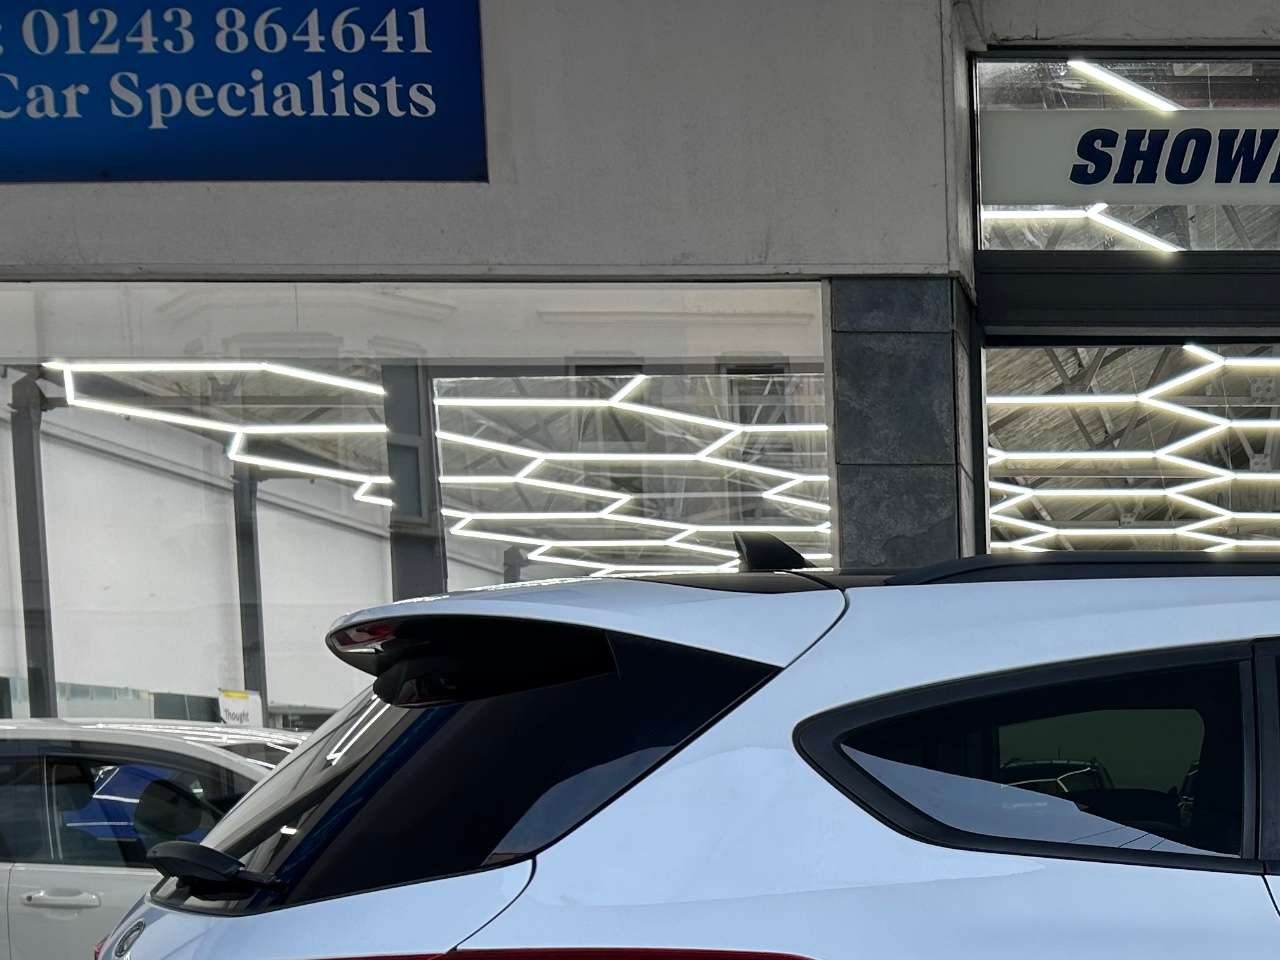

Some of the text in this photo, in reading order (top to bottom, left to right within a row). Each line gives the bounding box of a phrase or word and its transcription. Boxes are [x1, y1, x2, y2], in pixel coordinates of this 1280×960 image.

[22, 8, 195, 55] 01243
[215, 7, 433, 53] 864641
[110, 68, 437, 129] Specialists
